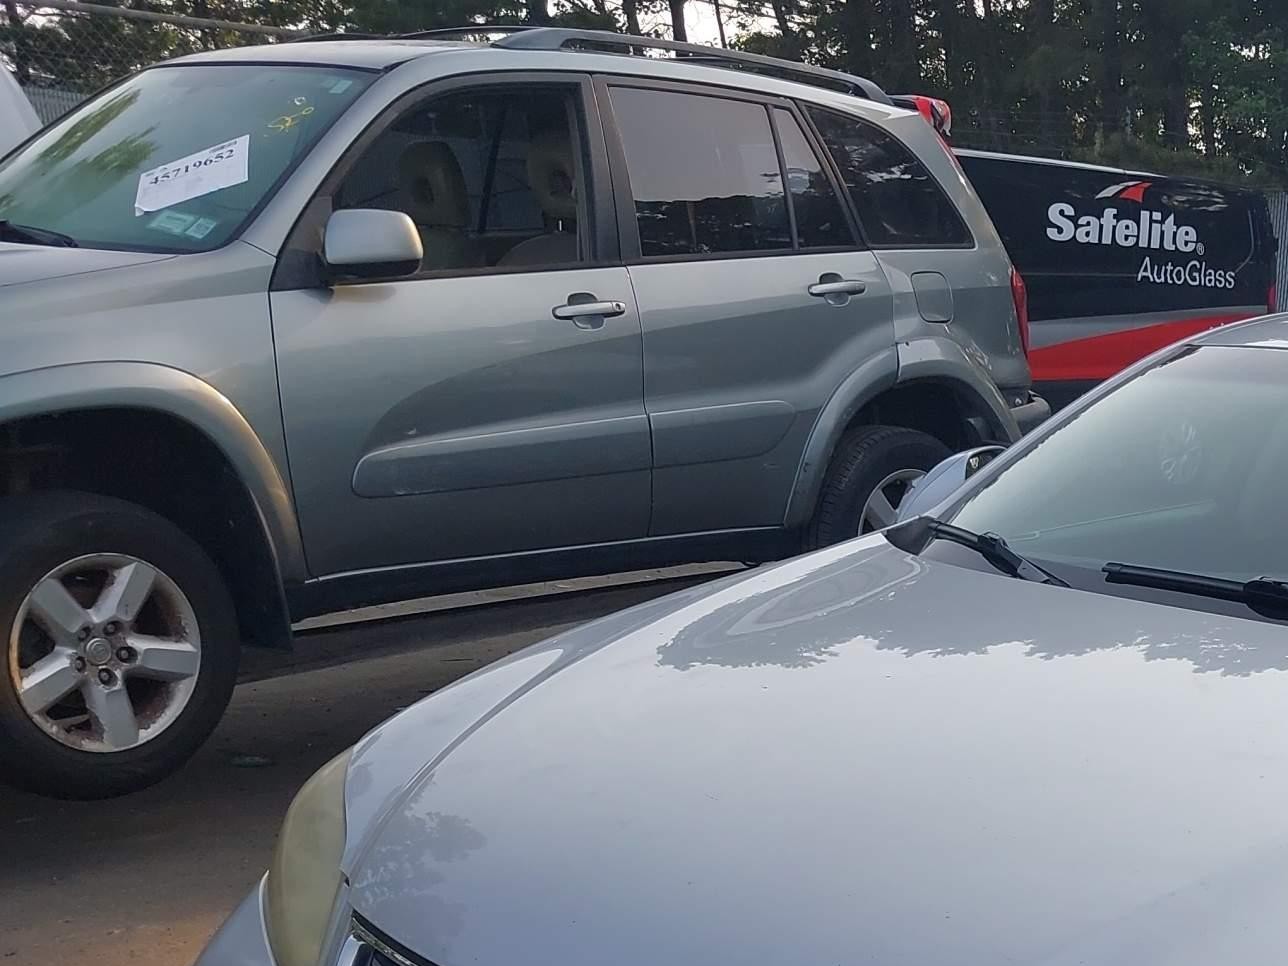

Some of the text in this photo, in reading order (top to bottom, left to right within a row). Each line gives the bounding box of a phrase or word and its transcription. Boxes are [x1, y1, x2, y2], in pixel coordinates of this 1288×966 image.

[149, 148, 235, 186] 45719652
[1046, 202, 1197, 254] Safelite
[1136, 256, 1236, 289] AutoGlass
